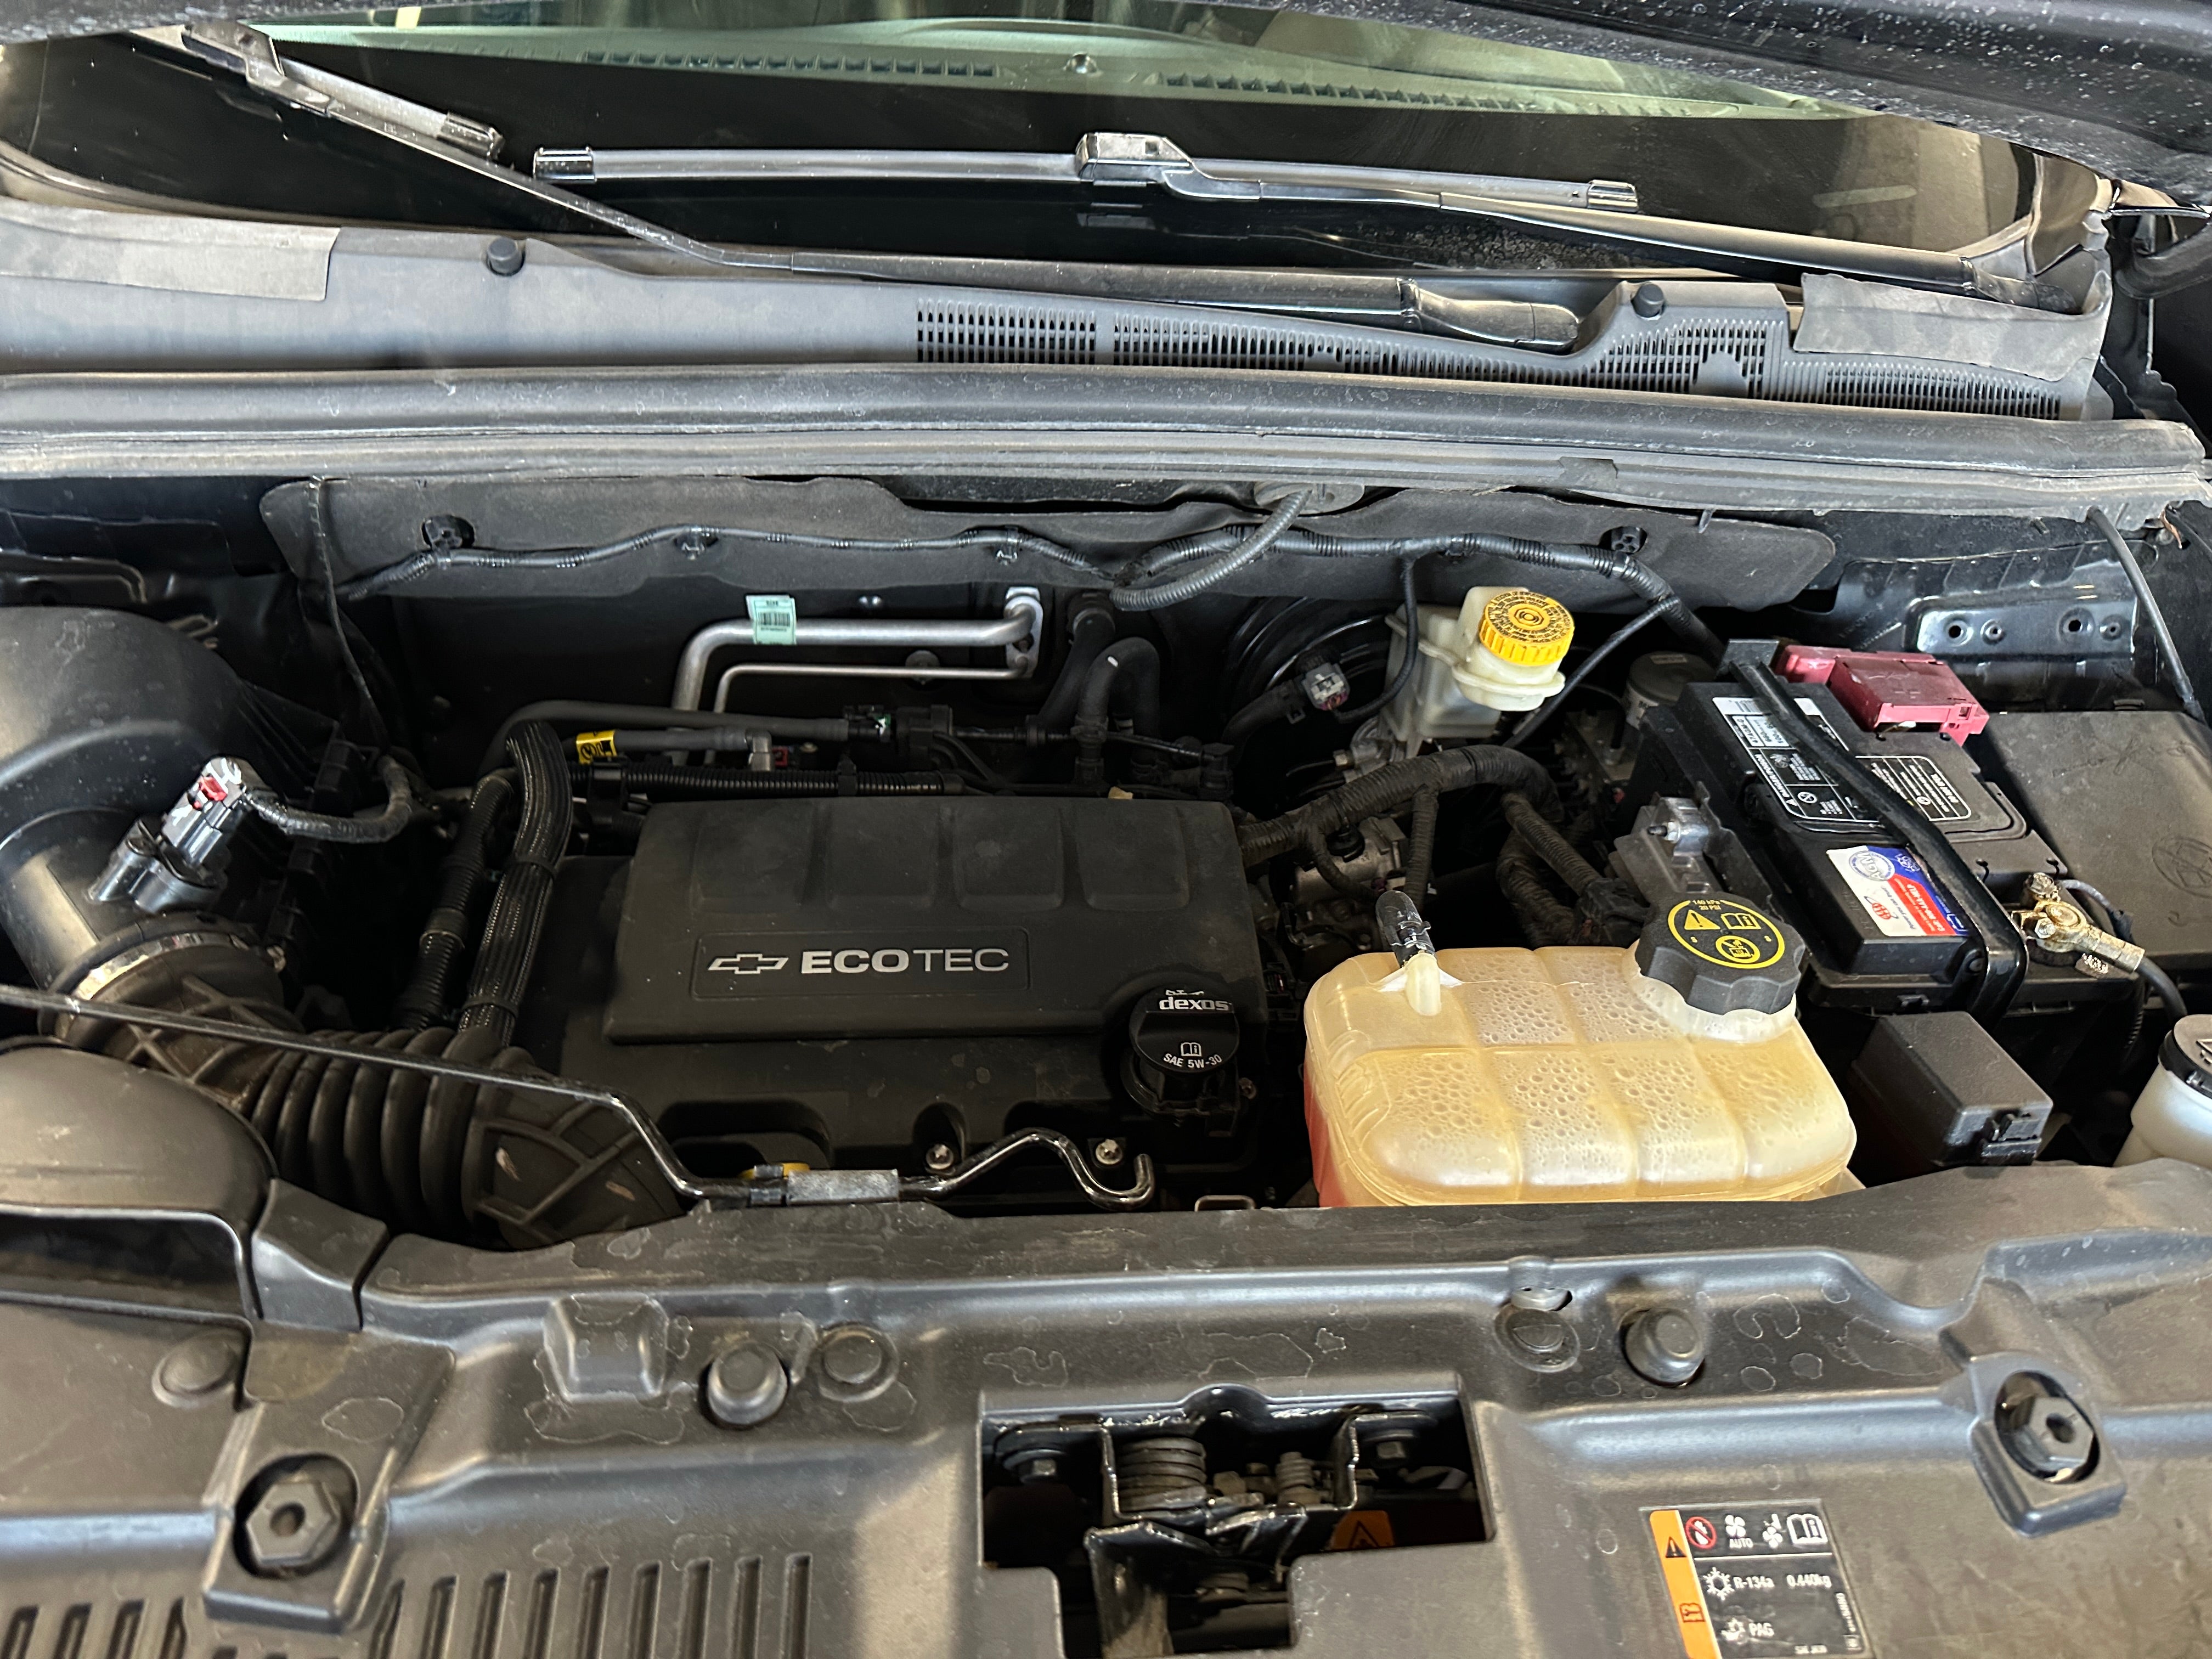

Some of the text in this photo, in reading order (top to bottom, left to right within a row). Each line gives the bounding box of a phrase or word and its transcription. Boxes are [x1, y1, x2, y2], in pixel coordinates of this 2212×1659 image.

[1754, 754, 1790, 798] DANGER/POISON
[1857, 852, 1884, 879] AGM
[1897, 906, 1906, 915] you
[801, 949, 1009, 974] ECOTEC
[1159, 996, 1230, 1011] dexos
[1163, 1053, 1223, 1069] SAE 5W-30
[1729, 1538, 1753, 1549] AUTO
[1733, 1574, 1832, 1589] R-134a 0.440kg
[1748, 1623, 1775, 1637] PAG
